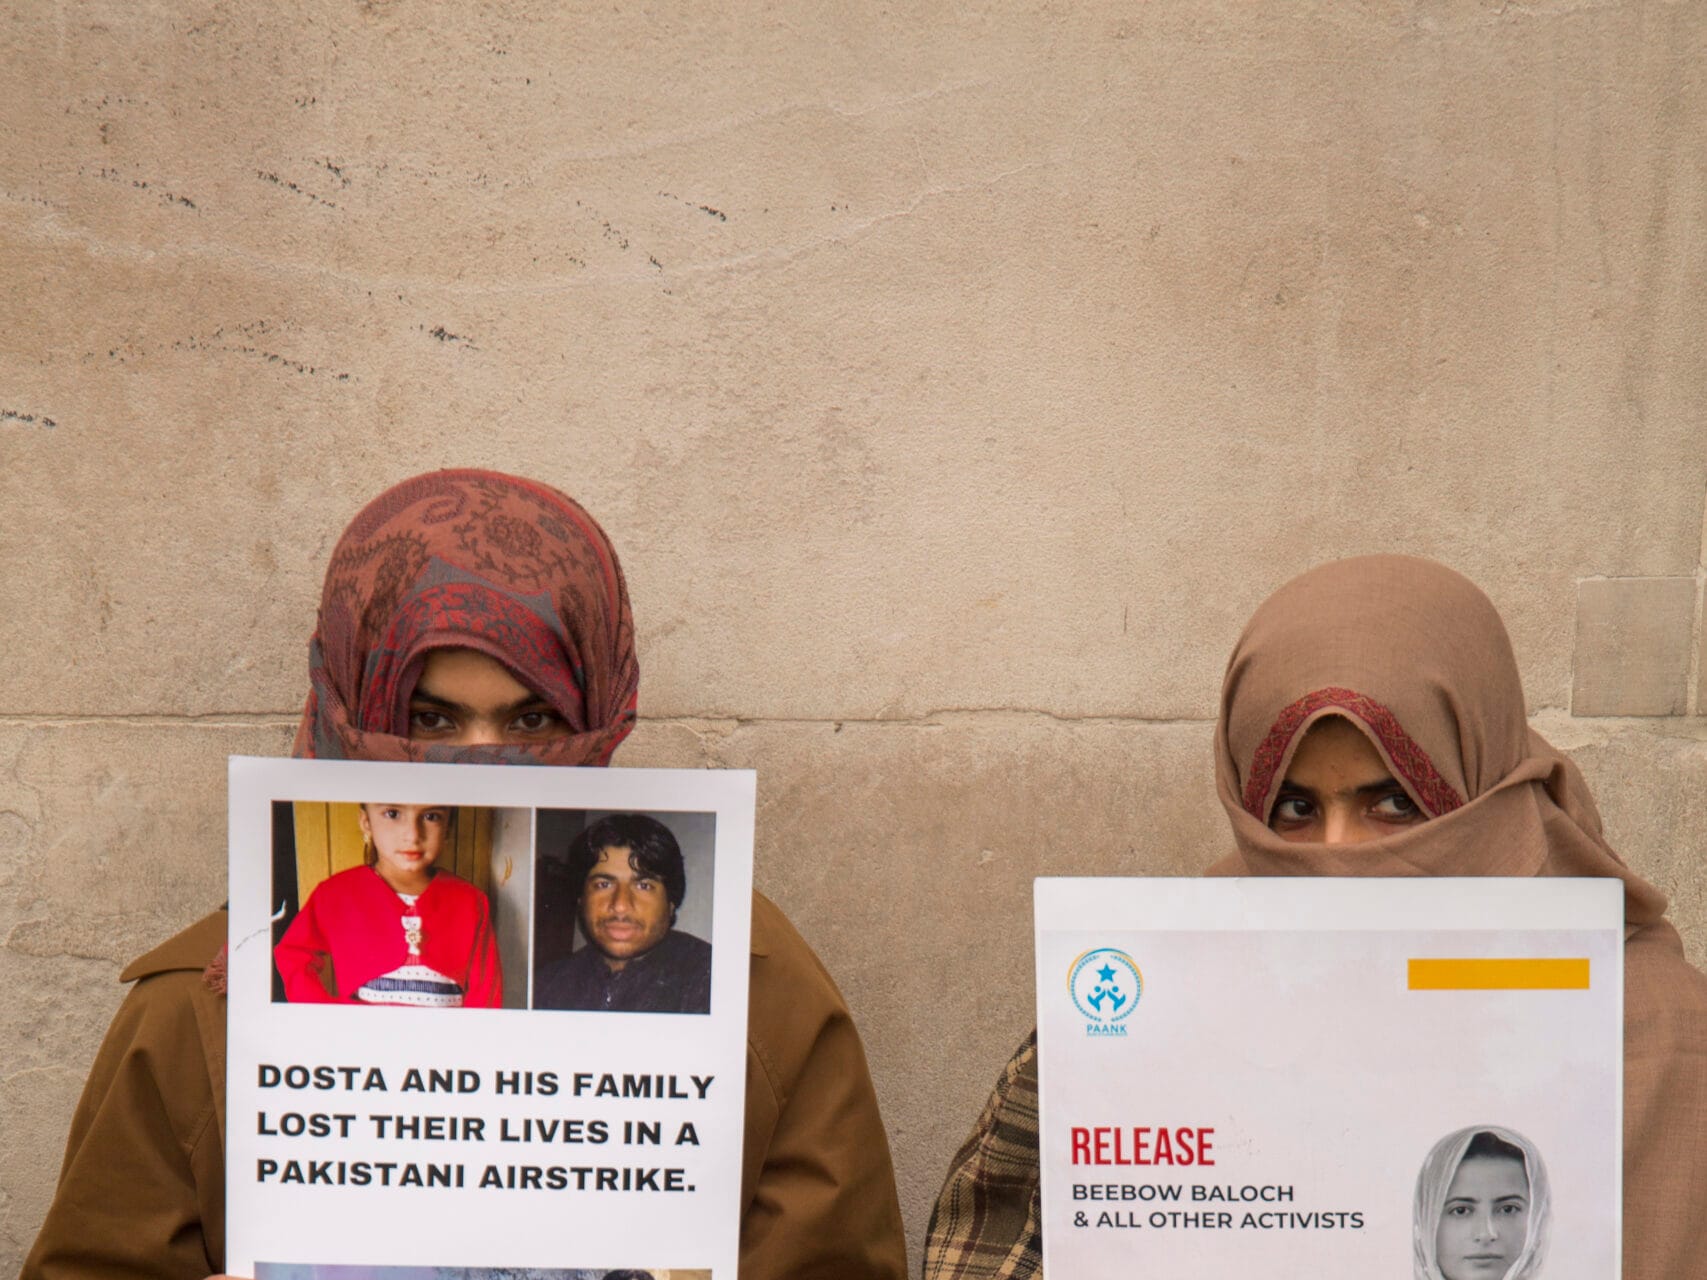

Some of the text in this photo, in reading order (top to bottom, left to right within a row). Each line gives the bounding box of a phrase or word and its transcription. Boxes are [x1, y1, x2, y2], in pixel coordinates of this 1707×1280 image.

[1086, 1023, 1128, 1033] PAANK
[258, 1064, 715, 1100] DOSTA AND HIS FAMILY
[257, 1111, 700, 1146] LOST THEIR LIVES IN A
[1070, 1126, 1217, 1167] RELEASE
[257, 1159, 696, 1192] PAKISTANI AIRSTRIKE.
[1072, 1183, 1294, 1202] BEEBOW BALOCH
[1073, 1210, 1365, 1229] & ALL OTHER ACTIVISTS
